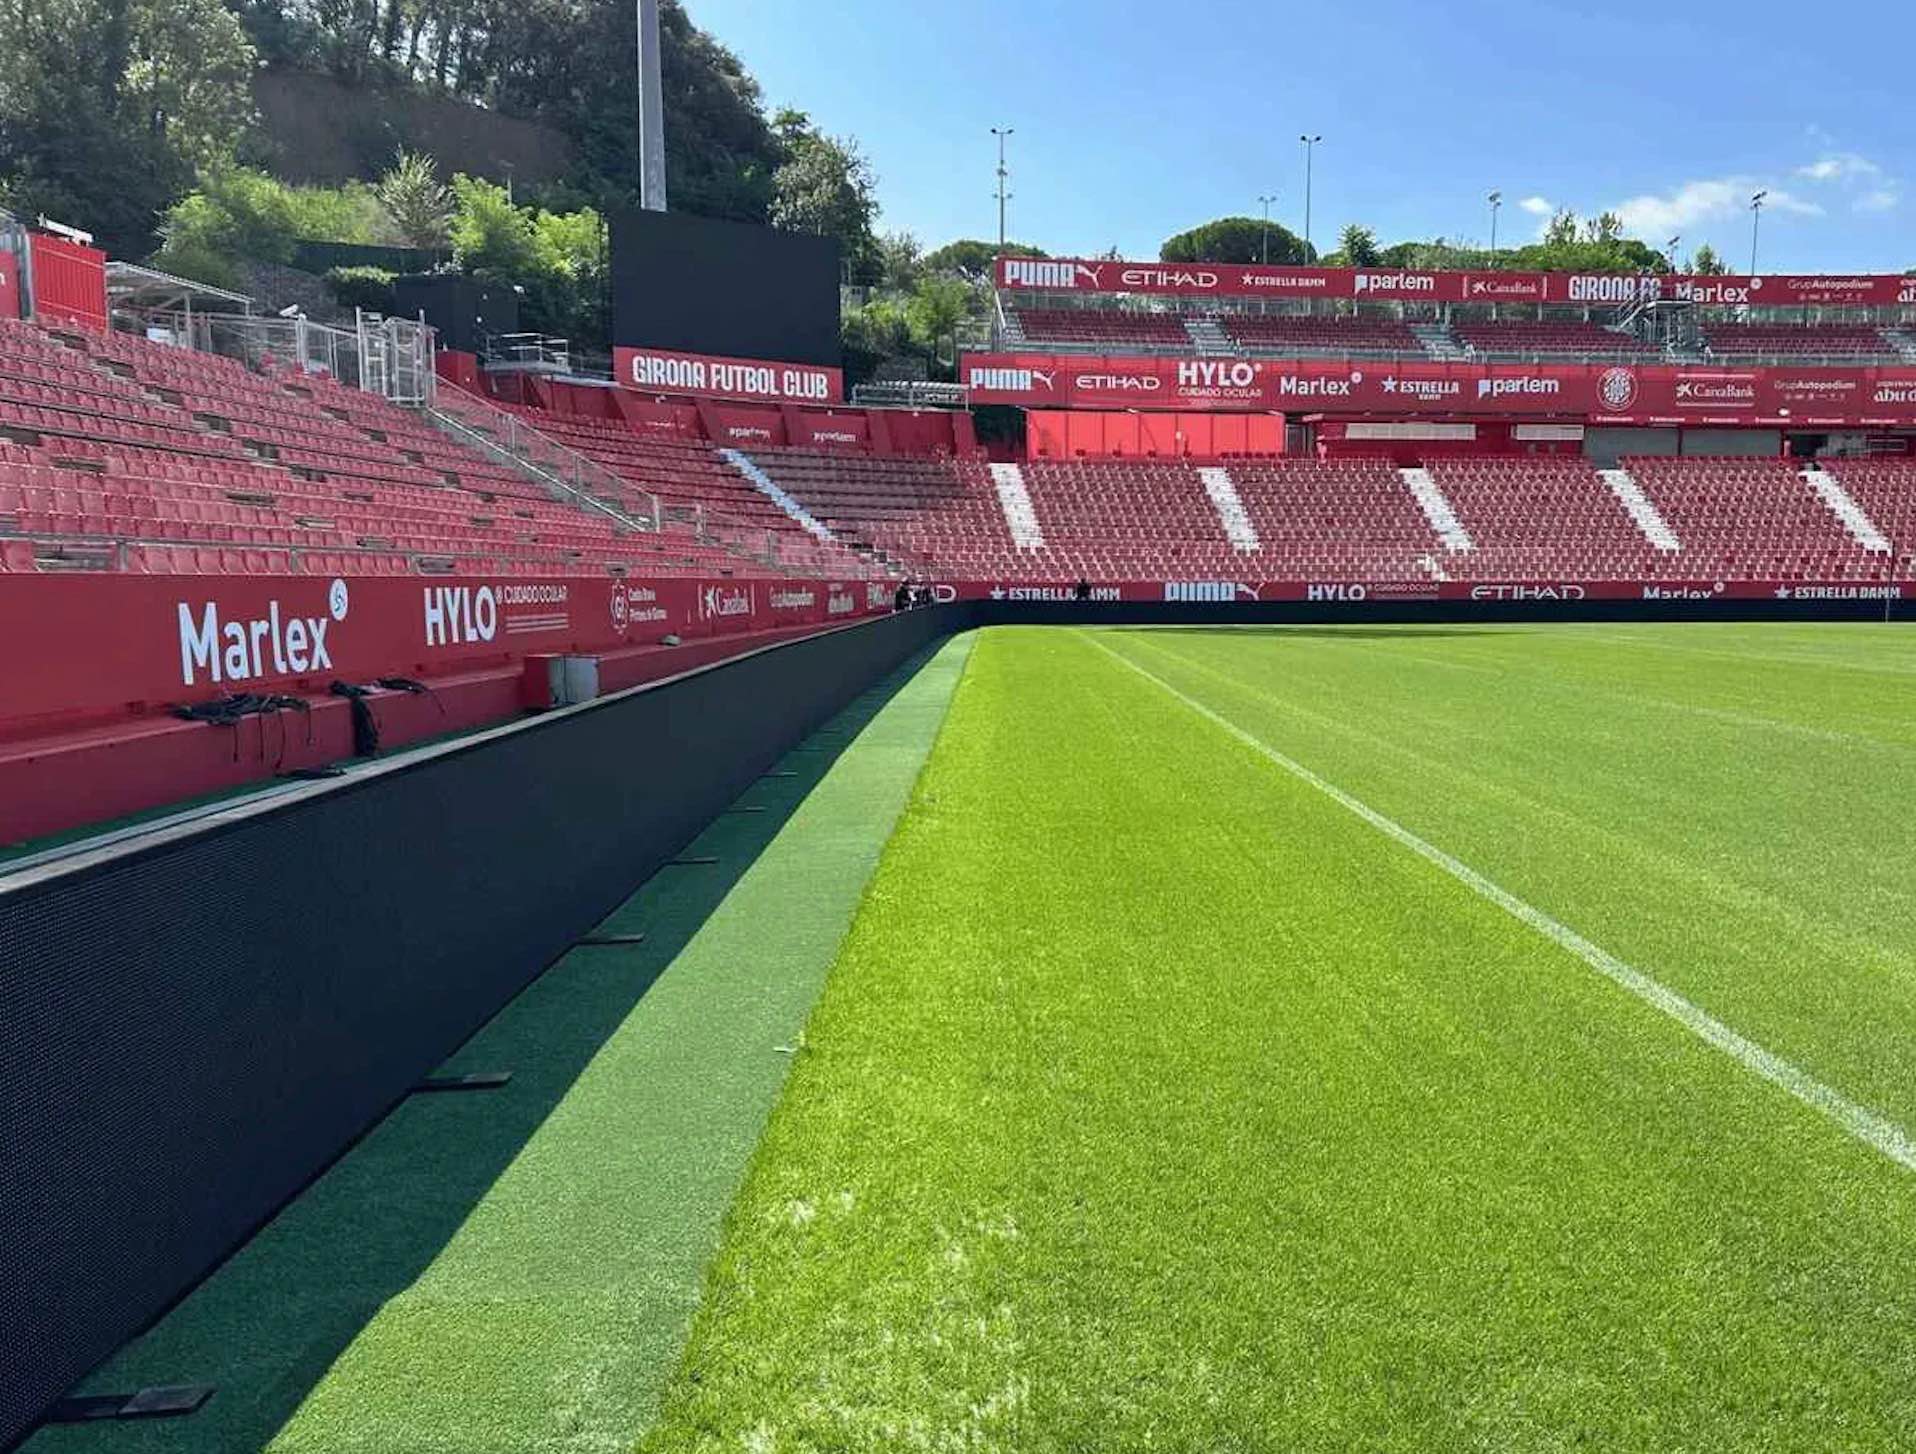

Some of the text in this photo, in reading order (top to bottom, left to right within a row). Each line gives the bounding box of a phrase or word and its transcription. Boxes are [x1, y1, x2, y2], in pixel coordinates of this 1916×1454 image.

[1005, 261, 1074, 287] PUMA
[1122, 270, 1218, 288] ETIHAD
[1370, 273, 1435, 293] parlem
[1568, 276, 1636, 300] GIRONA
[1675, 282, 1749, 302] Marlex
[632, 356, 829, 399] GIRONA FUTBOL CLUB
[970, 367, 1031, 390] PUMA
[1076, 375, 1160, 390] ETIHAD
[1178, 361, 1253, 386] HYLO
[1280, 376, 1350, 395] Marlex
[1401, 381, 1459, 393] ESTRELLA
[1493, 376, 1559, 397] parlem
[1308, 583, 1366, 601] HYLO
[1471, 584, 1585, 600] ETIHAD
[1795, 586, 1857, 600] ESTRELLA
[424, 585, 497, 647] HYLO
[178, 601, 333, 685] Marlex
